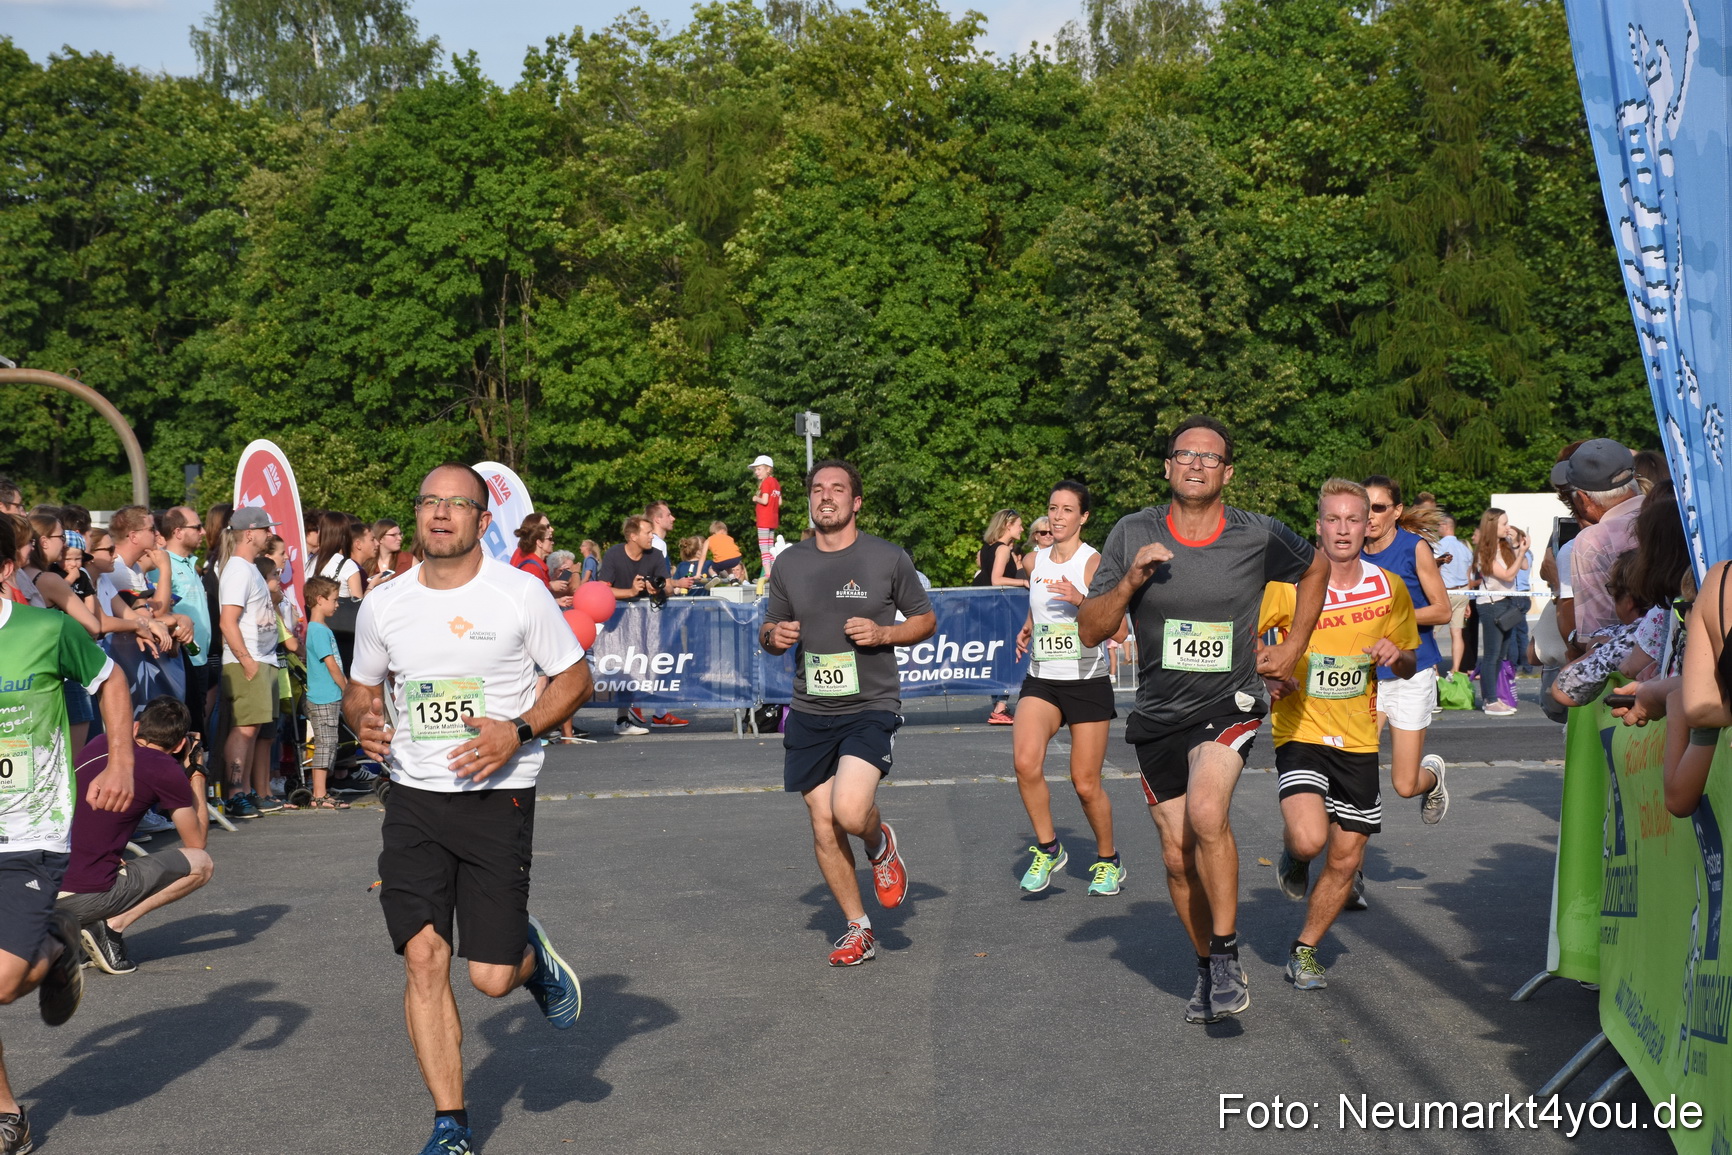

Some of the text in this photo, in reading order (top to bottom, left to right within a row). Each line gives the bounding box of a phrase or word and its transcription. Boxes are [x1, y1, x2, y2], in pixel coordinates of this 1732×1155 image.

[1039, 636, 1073, 650] 1156
[1173, 638, 1224, 658] 1489
[814, 669, 844, 685] 430
[898, 667, 992, 682] TOMOBILE
[1316, 670, 1362, 687] 1690
[416, 700, 475, 723] 1355
